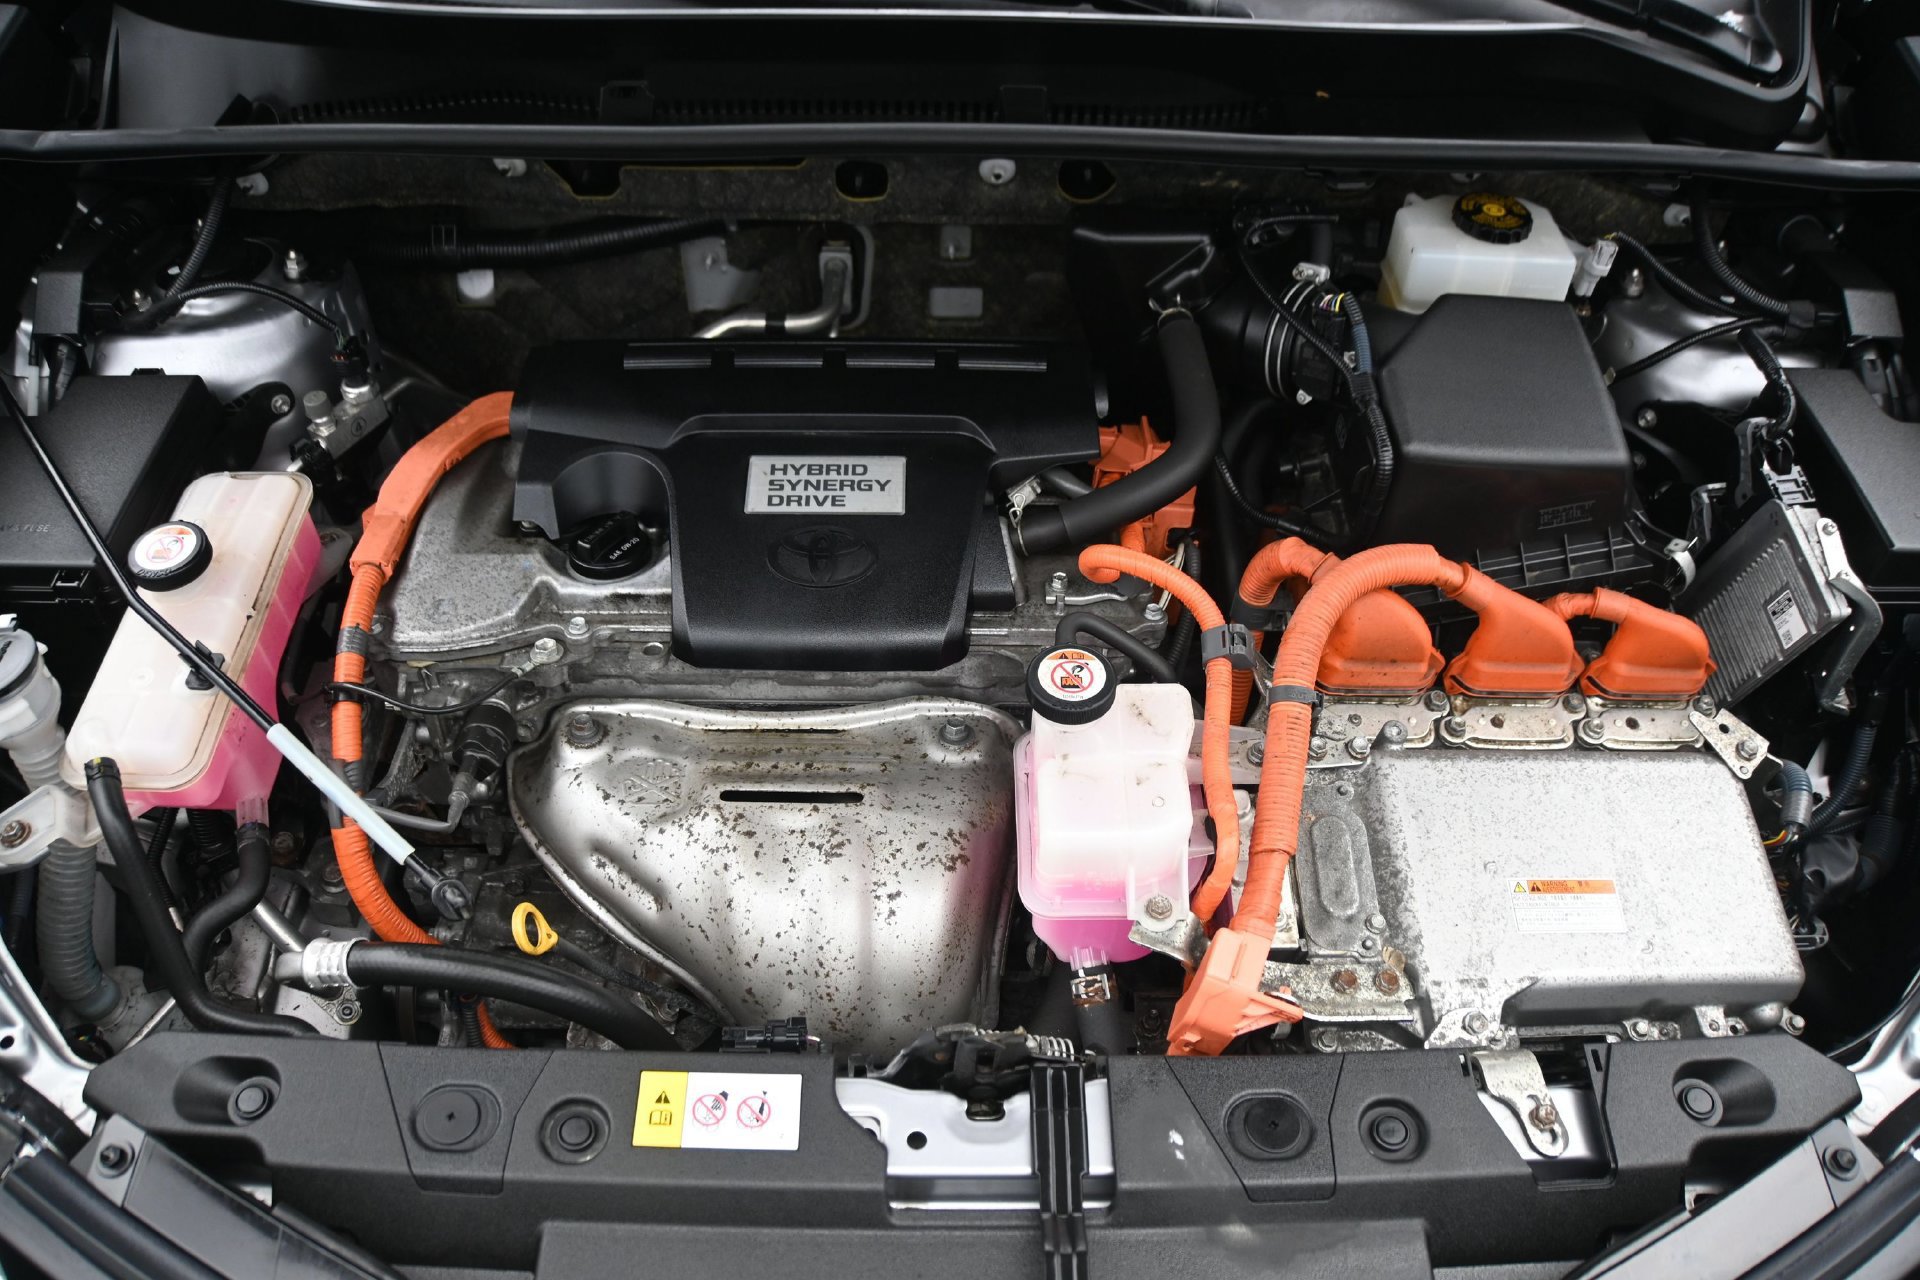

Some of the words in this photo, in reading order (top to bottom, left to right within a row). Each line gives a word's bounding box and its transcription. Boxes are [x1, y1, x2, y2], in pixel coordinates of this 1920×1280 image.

[770, 463, 868, 476] HYBRID
[768, 479, 892, 492] SYNERGY
[767, 494, 847, 507] DRIVE
[609, 549, 623, 560] SAE
